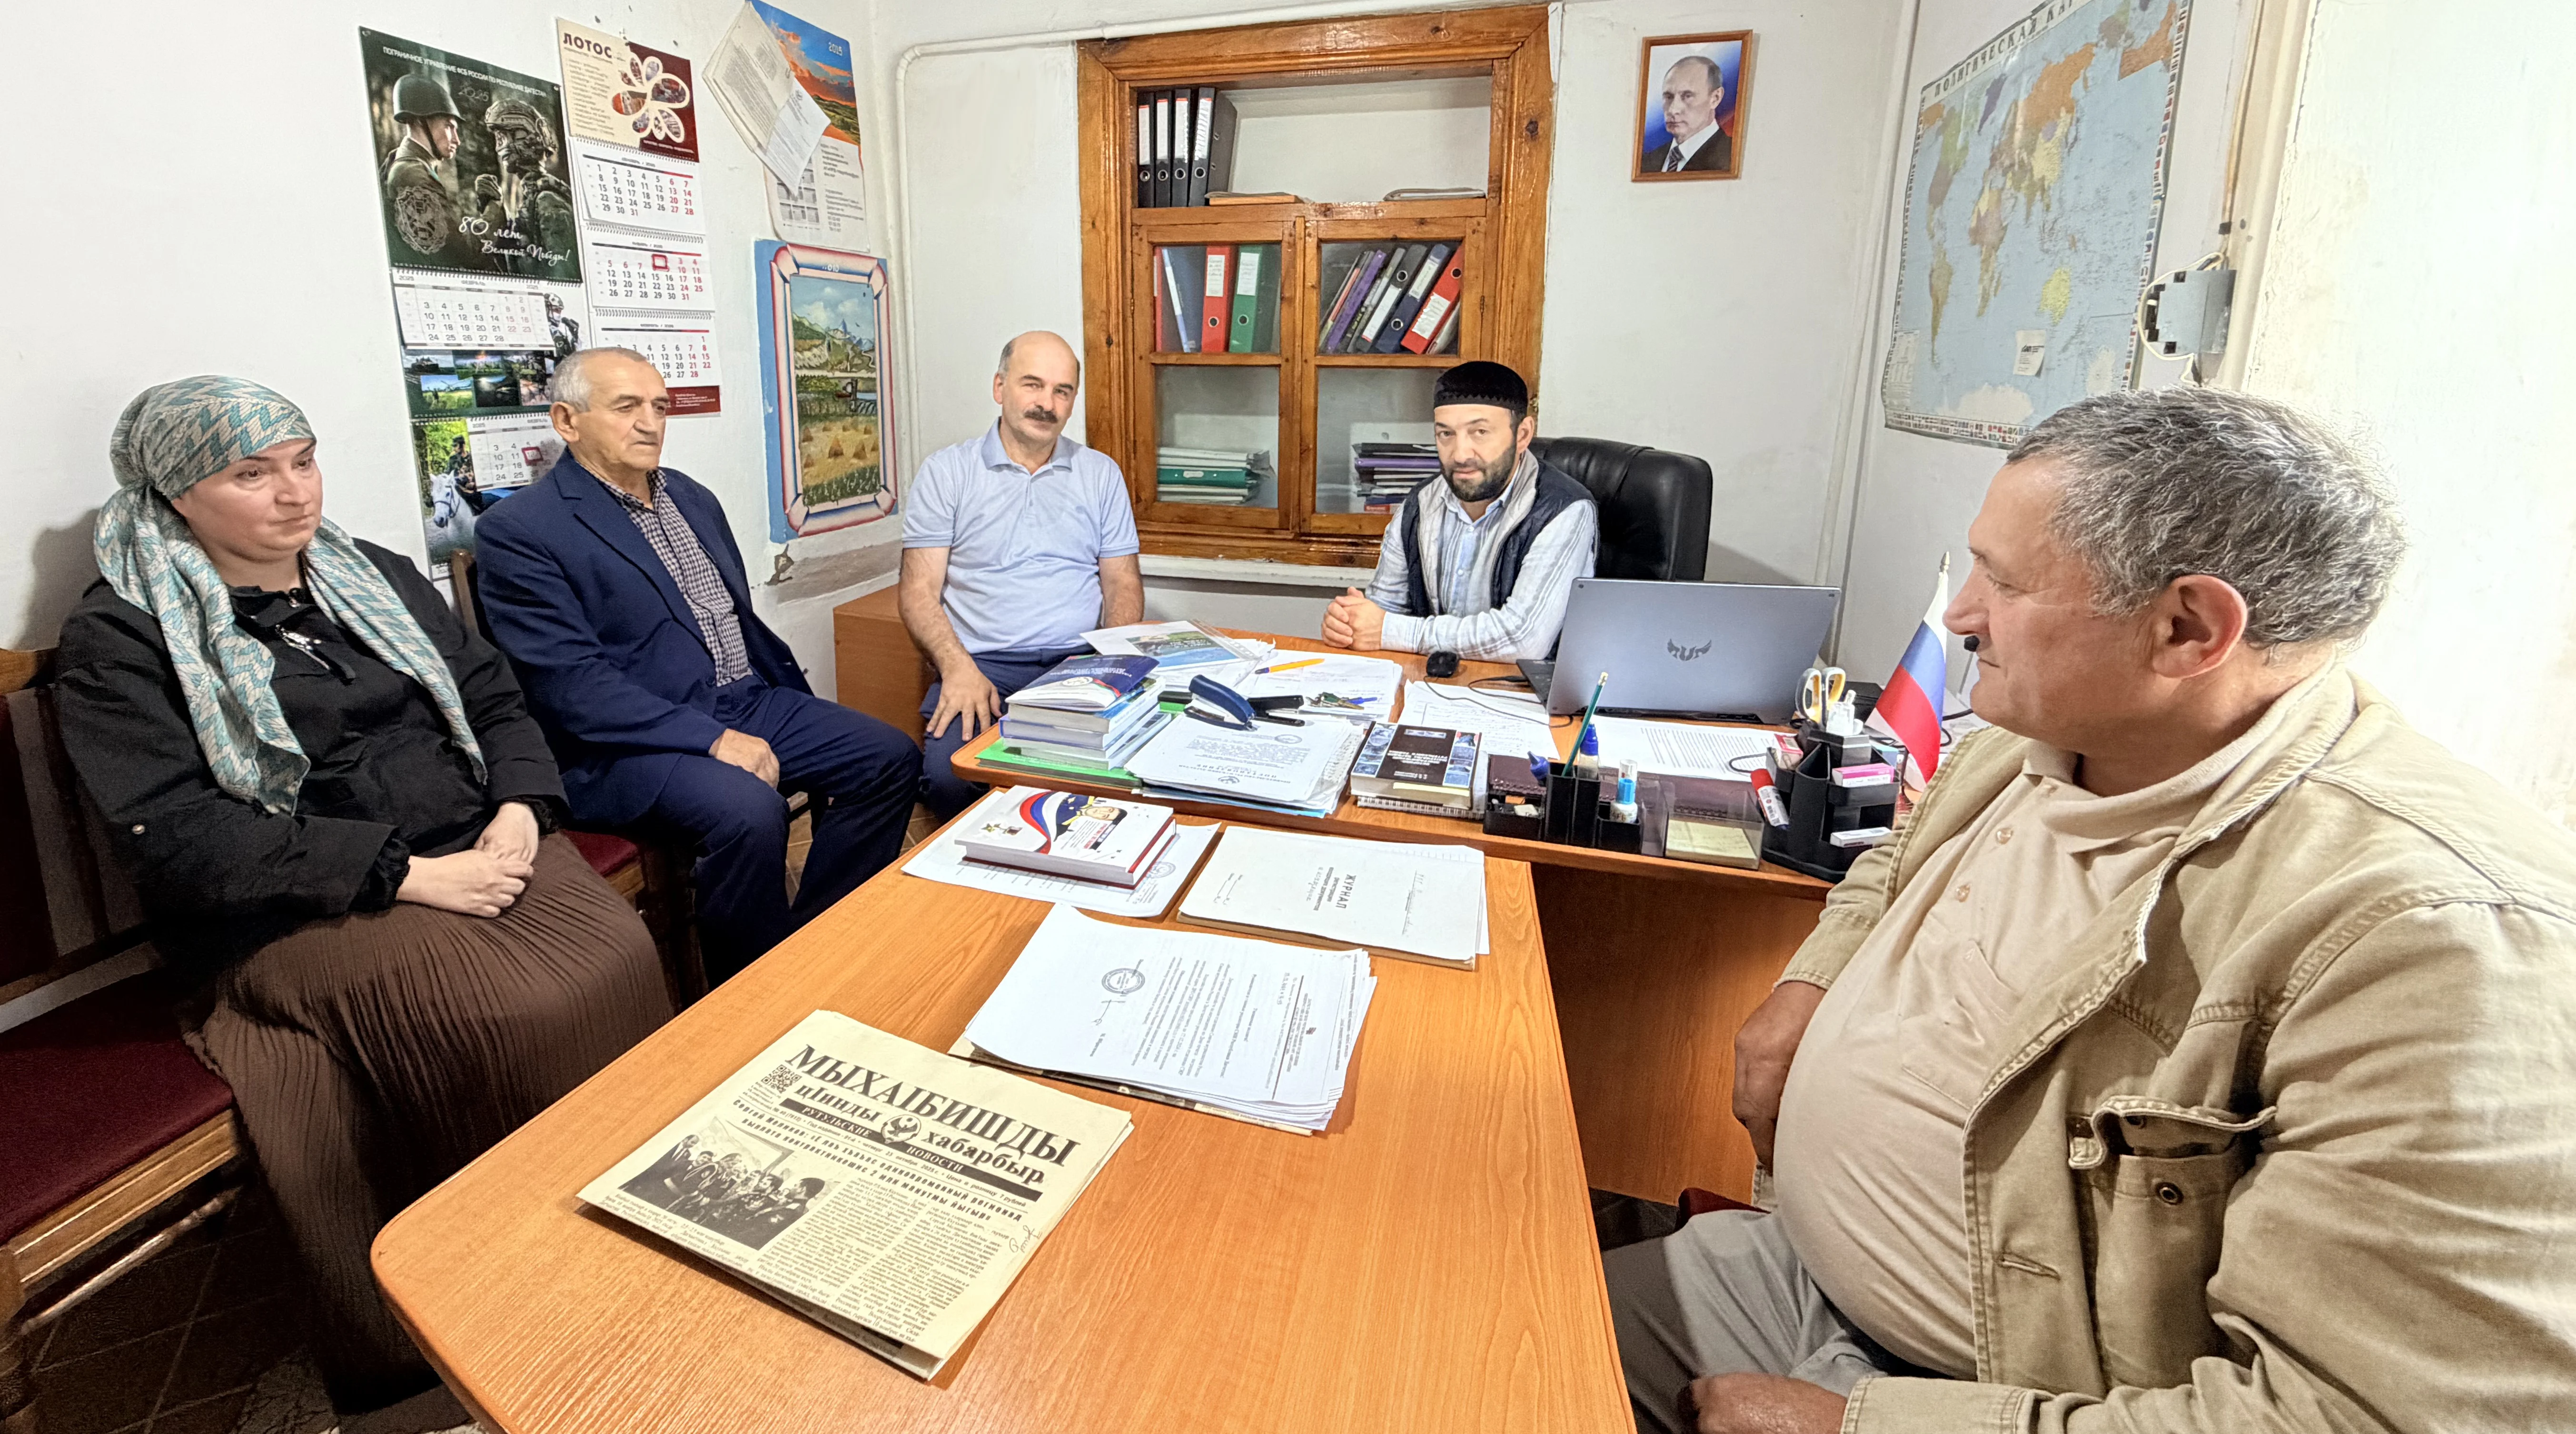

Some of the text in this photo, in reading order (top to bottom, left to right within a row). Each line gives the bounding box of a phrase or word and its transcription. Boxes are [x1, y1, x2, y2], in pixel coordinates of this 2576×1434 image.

[563, 32, 612, 59] ЛОТОС
[599, 184, 607, 192] 15
[600, 194, 609, 202] 22
[614, 196, 623, 204] 23
[459, 216, 524, 241] 80 лет
[480, 239, 571, 267] Великой Победы!
[1335, 874, 1357, 908] ЖУРНАЛ
[741, 1118, 783, 1138] выплата
[869, 1169, 879, 1177] 2
[877, 1173, 900, 1185] млн
[801, 1107, 964, 1173] РУТУЛЬСКИЕ НОВОСТИ
[733, 1099, 766, 1120] Сергей
[766, 1117, 808, 1139] Меликов:
[878, 1161, 971, 1201] единовременный
[969, 1197, 1023, 1222] регионад
[921, 1131, 1045, 1185] хабарбыр
[895, 1155, 918, 1166] октября
[945, 1173, 962, 1185] Цена
[970, 1184, 998, 1197] розницу
[1003, 1196, 1027, 1207] рублей
